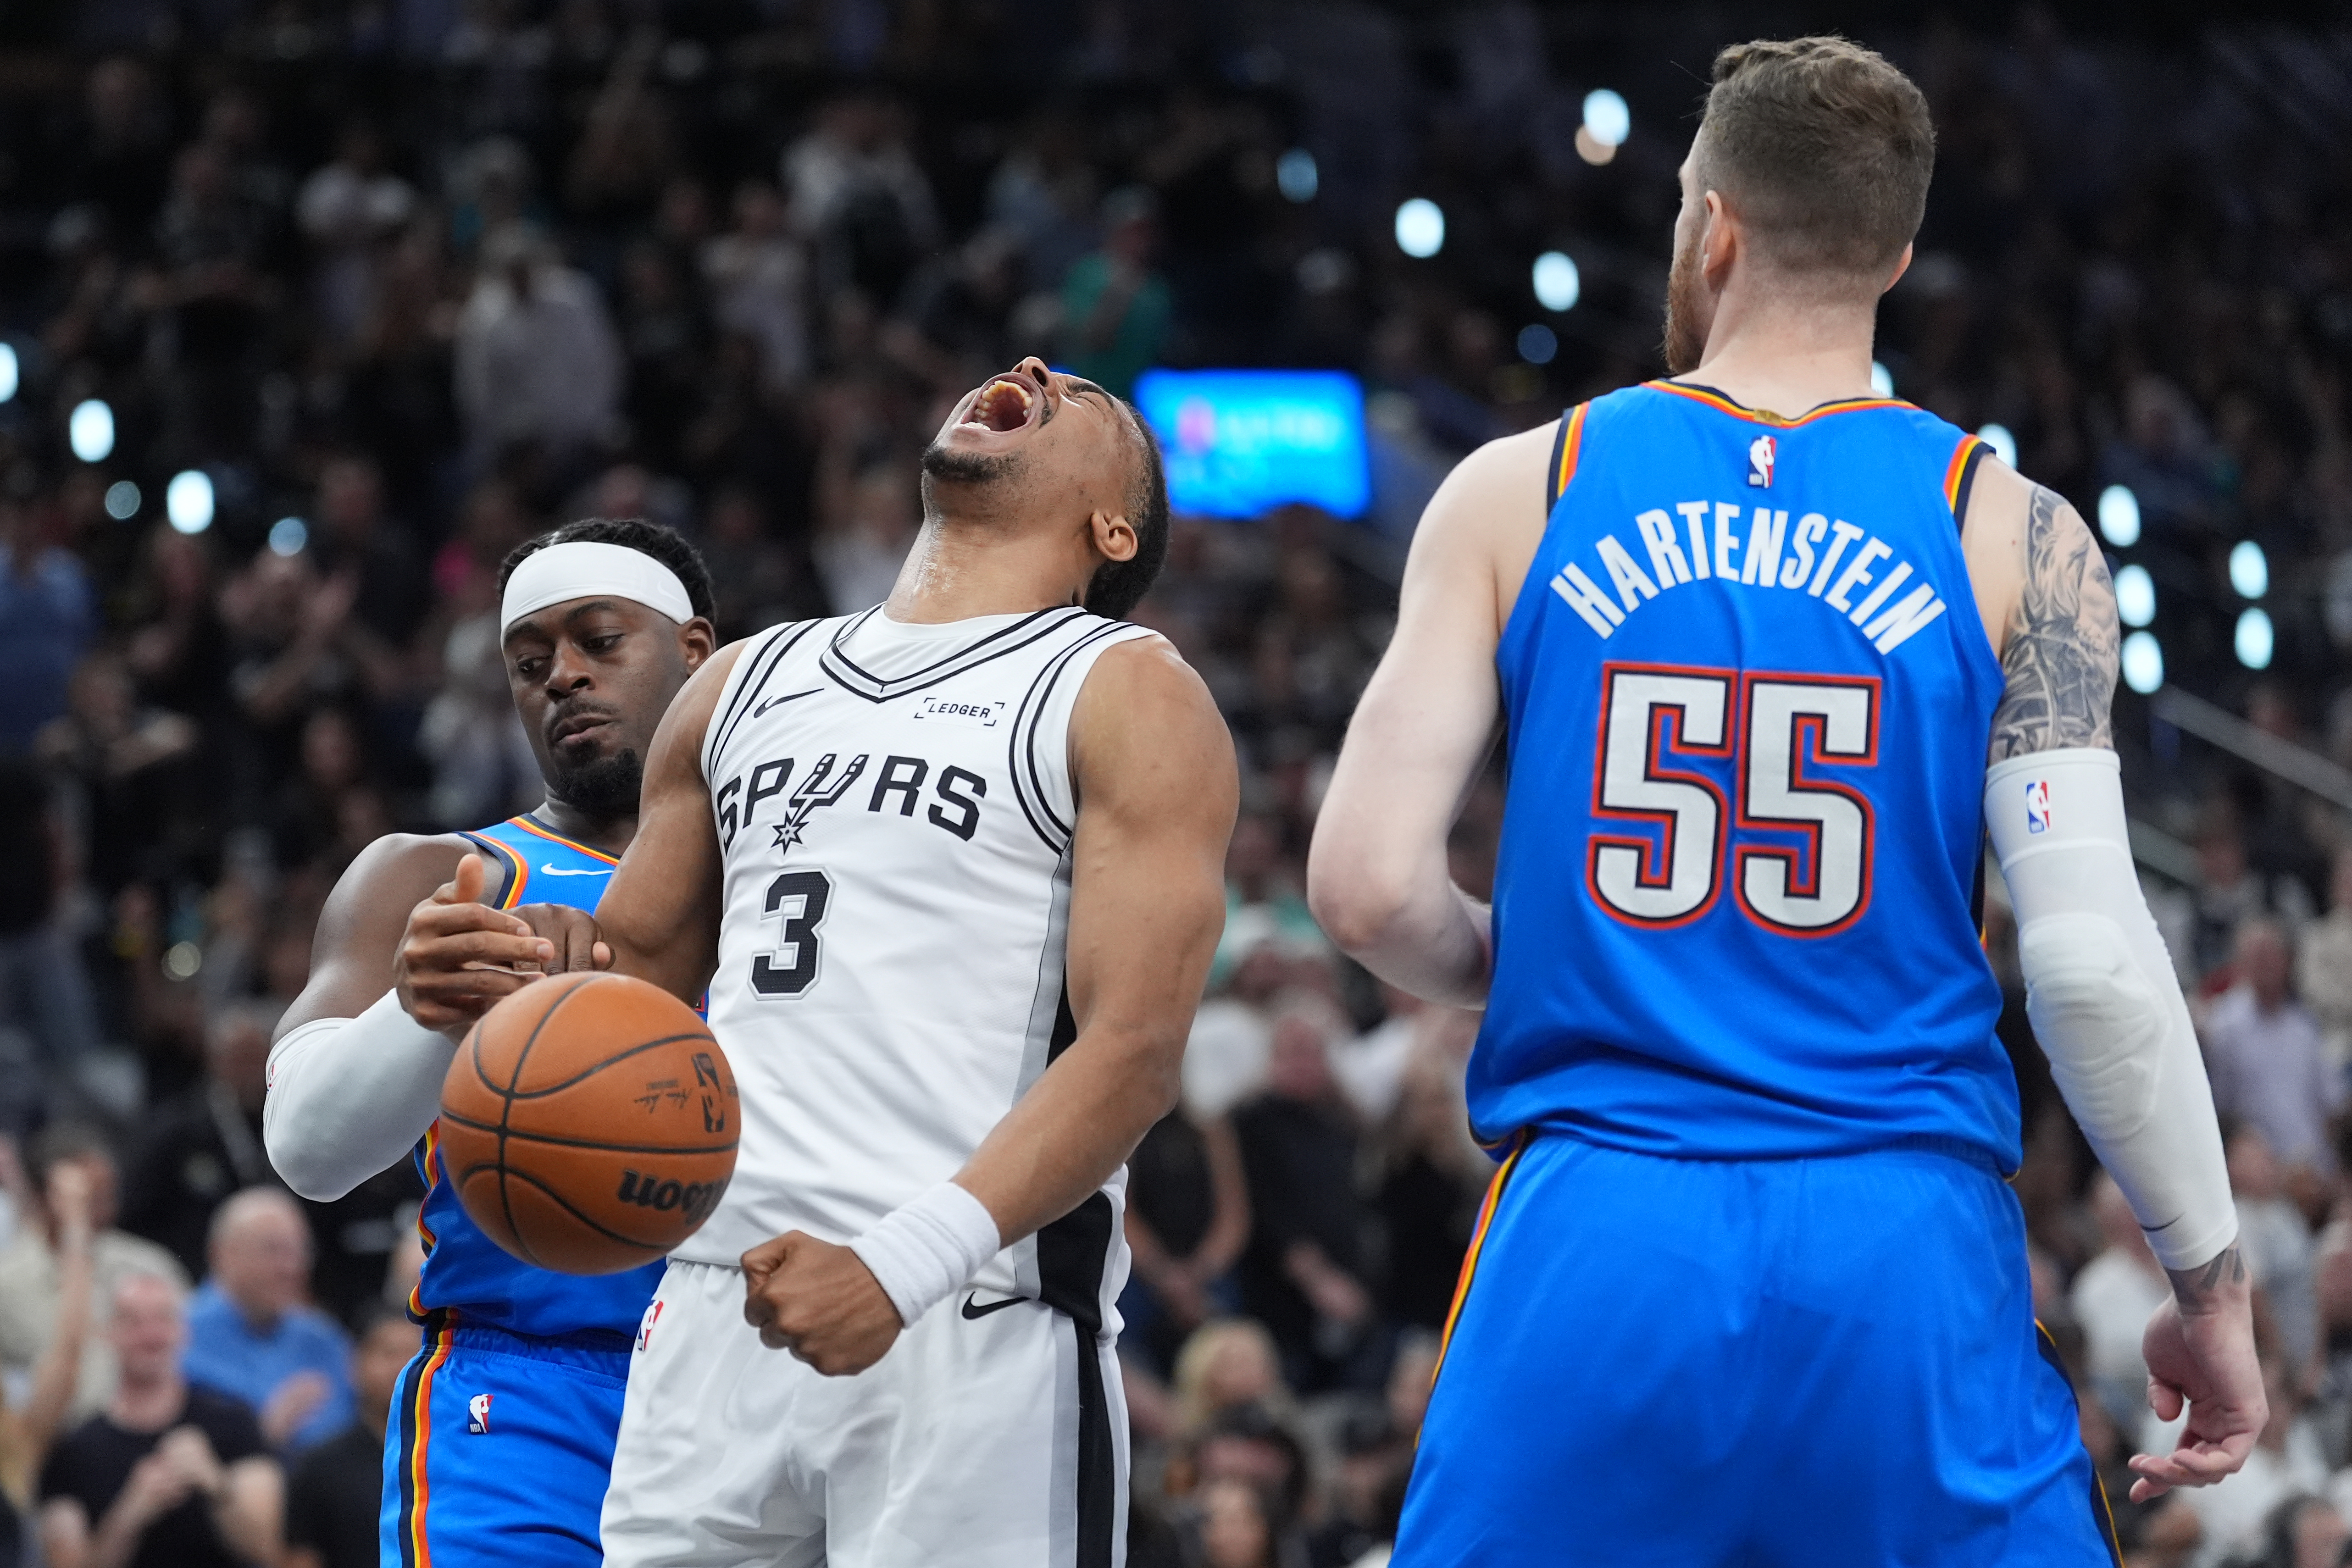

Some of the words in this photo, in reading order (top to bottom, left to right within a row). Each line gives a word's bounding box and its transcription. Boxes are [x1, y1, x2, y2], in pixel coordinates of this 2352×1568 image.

[1550, 500, 1946, 655] HARTENSTEIN
[928, 703, 991, 718] LEDGER
[717, 754, 987, 856] SPURS
[1586, 661, 1882, 939] 55
[748, 866, 836, 1000] 3
[470, 1423, 482, 1433] NBA
